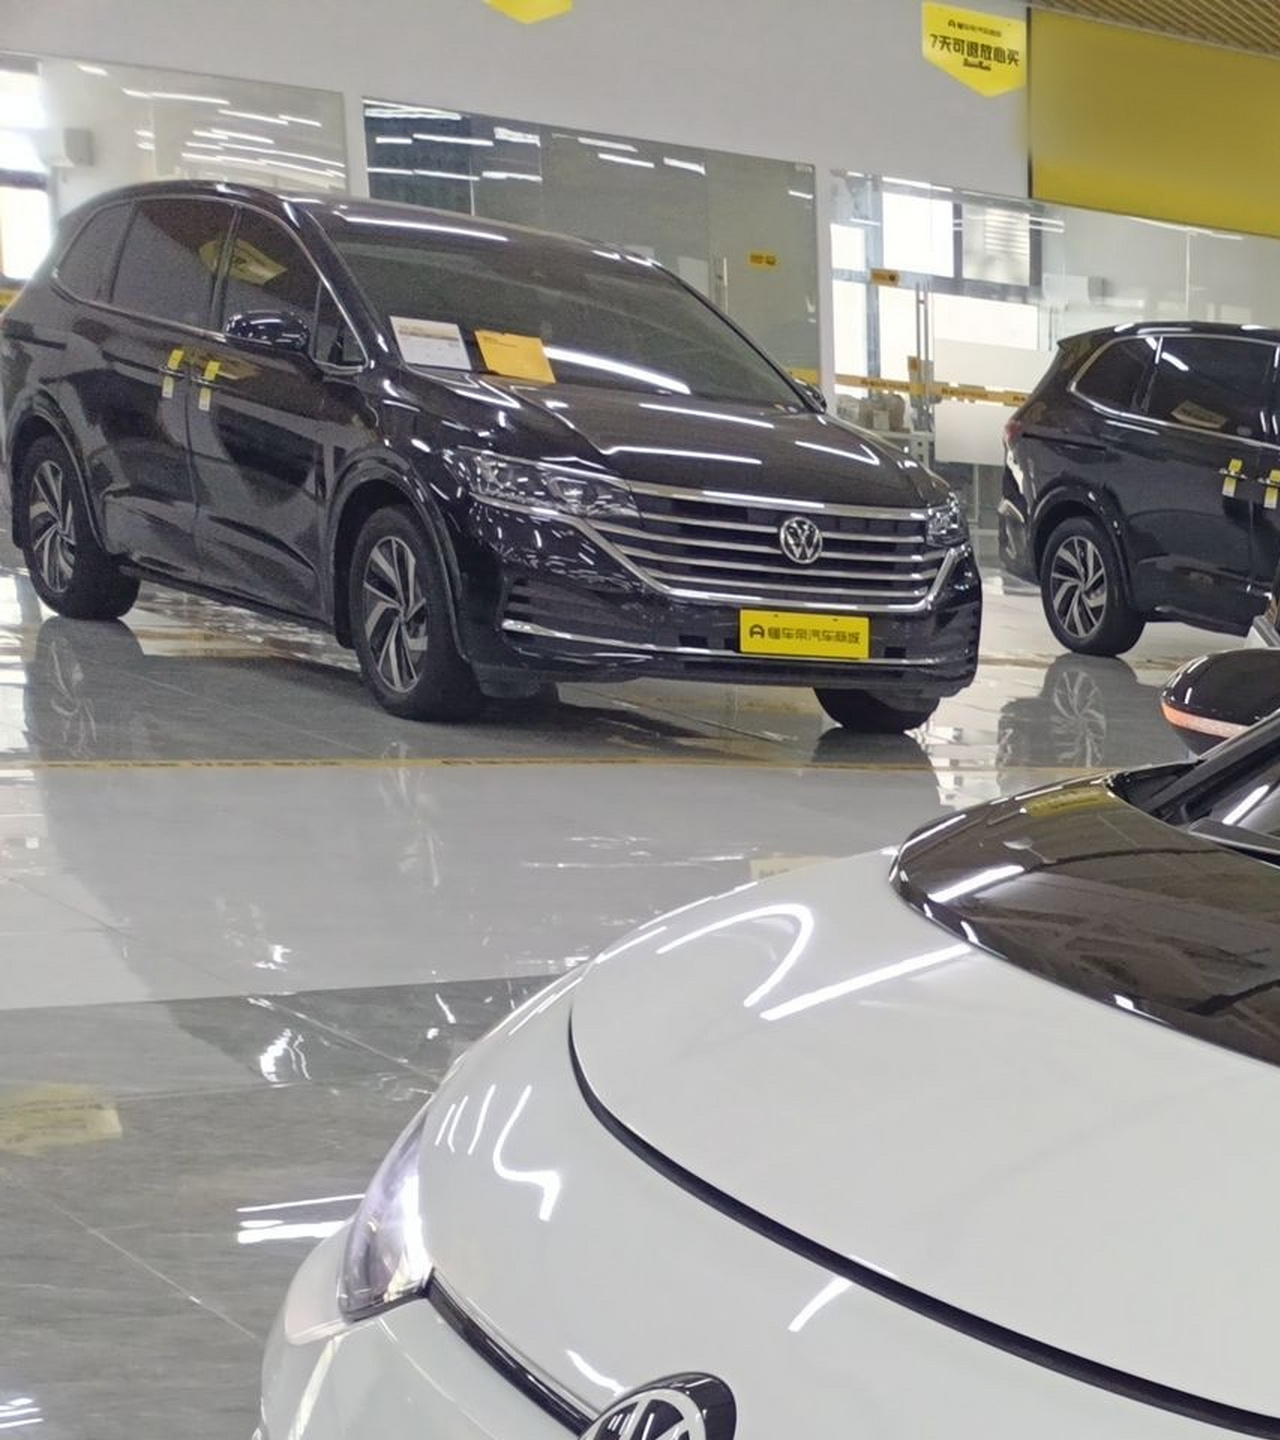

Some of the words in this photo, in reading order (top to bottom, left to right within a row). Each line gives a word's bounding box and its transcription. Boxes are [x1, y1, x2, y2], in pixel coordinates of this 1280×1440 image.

[929, 33, 1020, 66] 7天可退放心买
